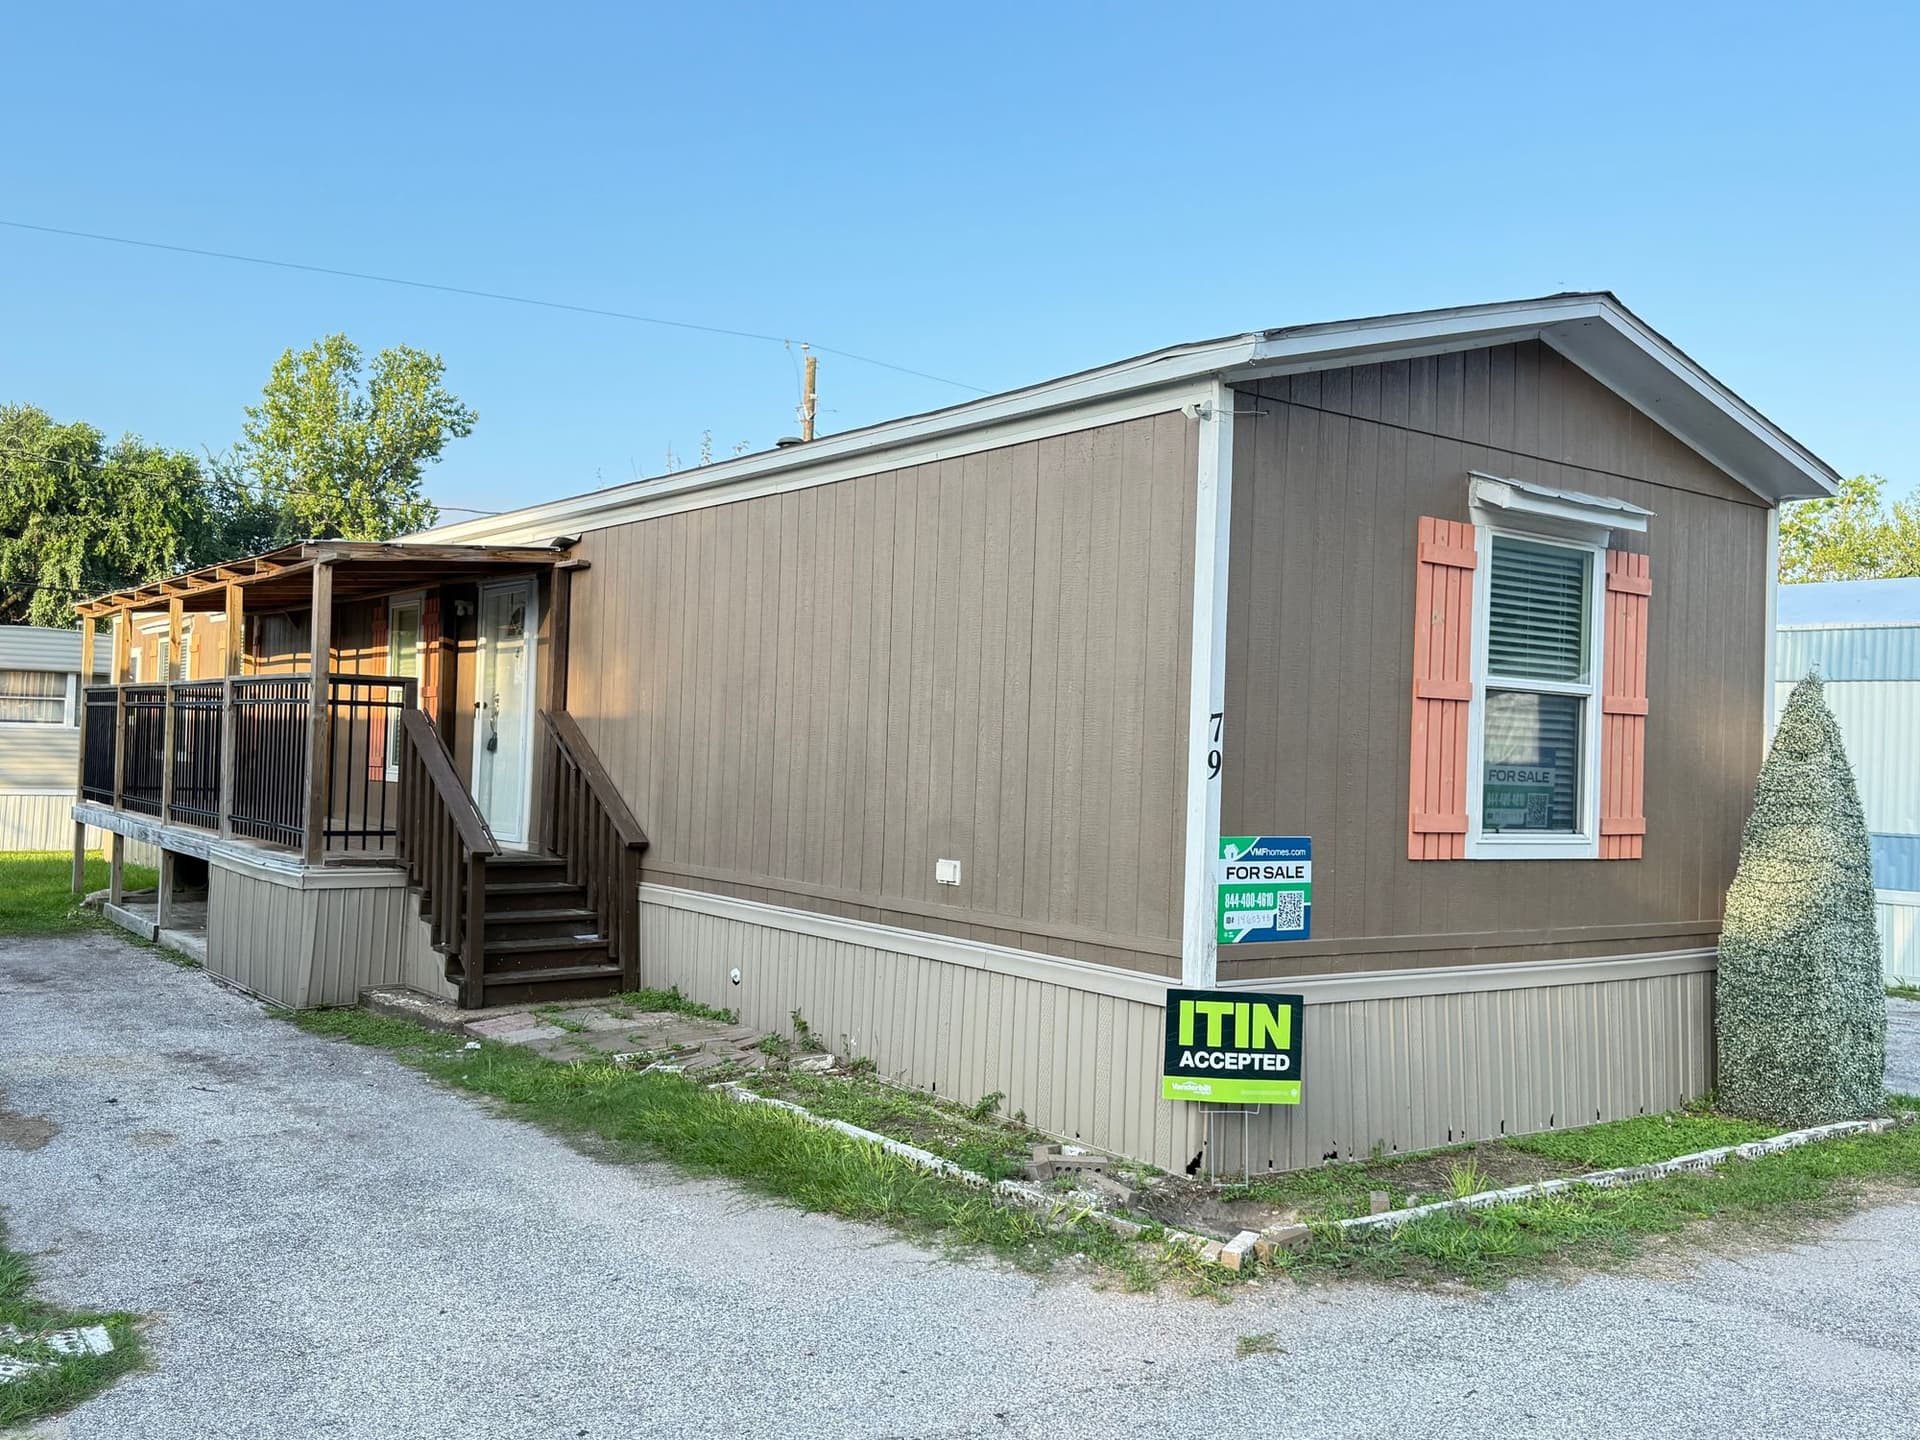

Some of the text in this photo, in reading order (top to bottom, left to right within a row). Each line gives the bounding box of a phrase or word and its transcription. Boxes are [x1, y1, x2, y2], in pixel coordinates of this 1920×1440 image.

[1208, 712, 1223, 780] 79
[1488, 769, 1550, 783] FOR SALE
[1250, 847, 1306, 857] VMFhomes.com
[1226, 866, 1305, 880] FOR SALE
[1179, 1000, 1292, 1050] ITIN
[1179, 1050, 1291, 1071] ACCEPTED
